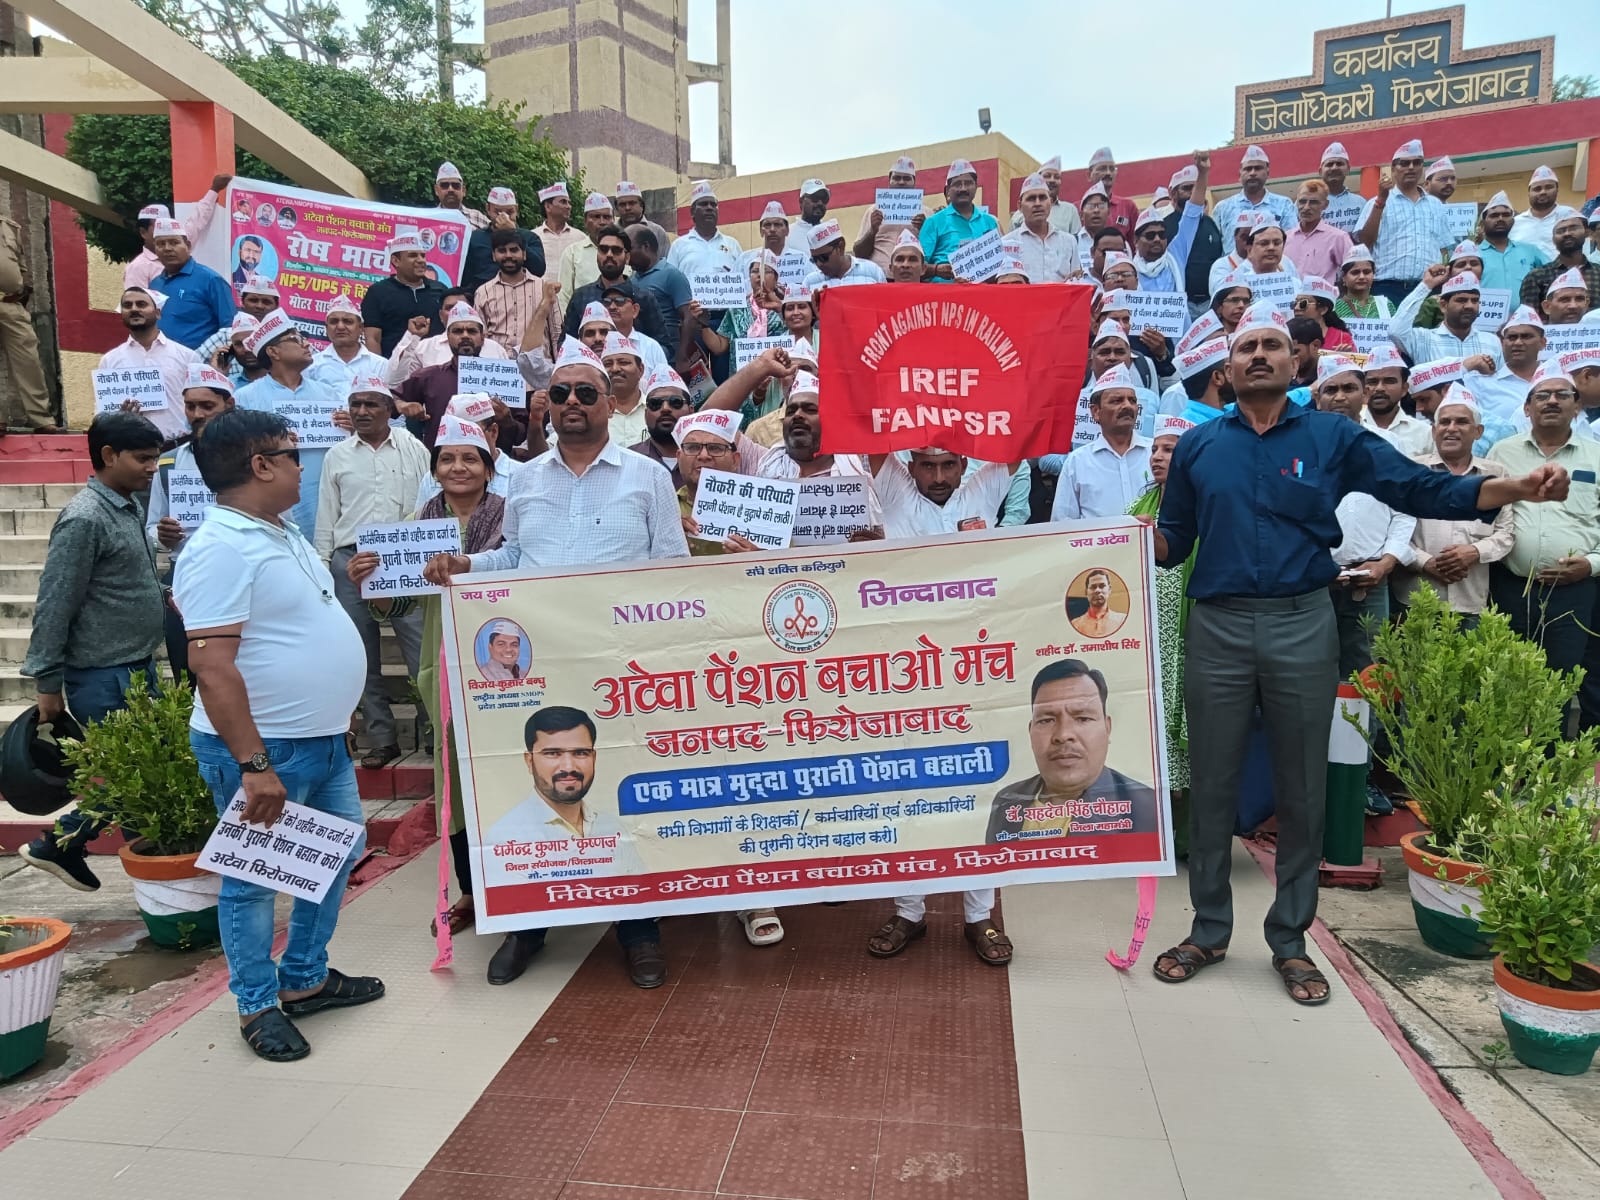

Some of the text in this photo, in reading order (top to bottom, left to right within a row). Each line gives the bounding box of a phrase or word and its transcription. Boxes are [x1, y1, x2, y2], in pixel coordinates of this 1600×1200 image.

[1334, 33, 1442, 77] कार्यालय
[1250, 84, 1375, 132] जिलाधिकारी
[286, 231, 333, 262] रोष
[279, 272, 338, 295] NPS/UPS
[860, 301, 1022, 372] FRONT AGAINST NPS IN RAILWAY
[121, 371, 132, 382] की
[900, 367, 980, 397] IREF
[715, 414, 730, 428] करो
[871, 404, 1013, 436] FANPSR
[705, 477, 795, 505] नौकरी की परिपाटी
[177, 511, 200, 521] अटेवा
[697, 499, 718, 515] पुरानी
[736, 503, 744, 518] है
[762, 507, 773, 522] की
[400, 528, 410, 542] को
[410, 527, 426, 542] शहीद
[427, 530, 437, 540] का
[437, 525, 449, 540] दर्जा
[698, 523, 725, 537] अटेवा
[1069, 533, 1130, 548] जय अटेवा
[382, 550, 402, 571] पुरानी
[403, 548, 421, 565] पेंशन
[800, 558, 847, 575] कलियुगे
[368, 576, 396, 591] अटेवा
[460, 588, 510, 603] जय युवा
[858, 576, 998, 609] जिन्दाबाद
[612, 599, 706, 626] NMOPS
[1035, 644, 1061, 656] शहीद
[1121, 638, 1141, 650] सिंह
[593, 627, 1016, 719] अटेवा पेंशन बचाओ मंच
[633, 778, 673, 804] एक
[678, 772, 723, 798] मात्र
[794, 759, 857, 797] पुरानी
[860, 754, 918, 781] पेंशन
[924, 746, 994, 776] बहाली
[657, 820, 685, 839] सभी
[688, 815, 733, 836] विभागों
[735, 814, 749, 832] के
[815, 802, 879, 824] कर्मचारियों
[882, 801, 901, 821] एवं
[903, 795, 977, 816] अधिकारियों
[1024, 803, 1064, 821] सहदेव
[1065, 799, 1091, 818] सिंह
[1093, 797, 1132, 817] चौहान
[298, 816, 316, 836] शहीद
[326, 827, 346, 844] दर्जा
[1069, 819, 1132, 833] जिला महामंत्री
[217, 821, 247, 842] उनकी
[242, 828, 273, 849] पुरानी
[272, 833, 296, 856] पेंशन
[295, 844, 322, 865] बहाल
[493, 840, 532, 857] धर्मेन्द्र
[535, 840, 568, 858] कुमार
[738, 826, 898, 857] की पुरानी पेंशन बहाल करो।
[209, 851, 320, 893] अटेवा फिरोजाबाद
[505, 862, 529, 872] जिला
[658, 874, 730, 894] अटेवा
[735, 868, 800, 886] पेंशन
[806, 858, 890, 880] बचाओ
[954, 845, 1099, 870] फिरोजाबाद
